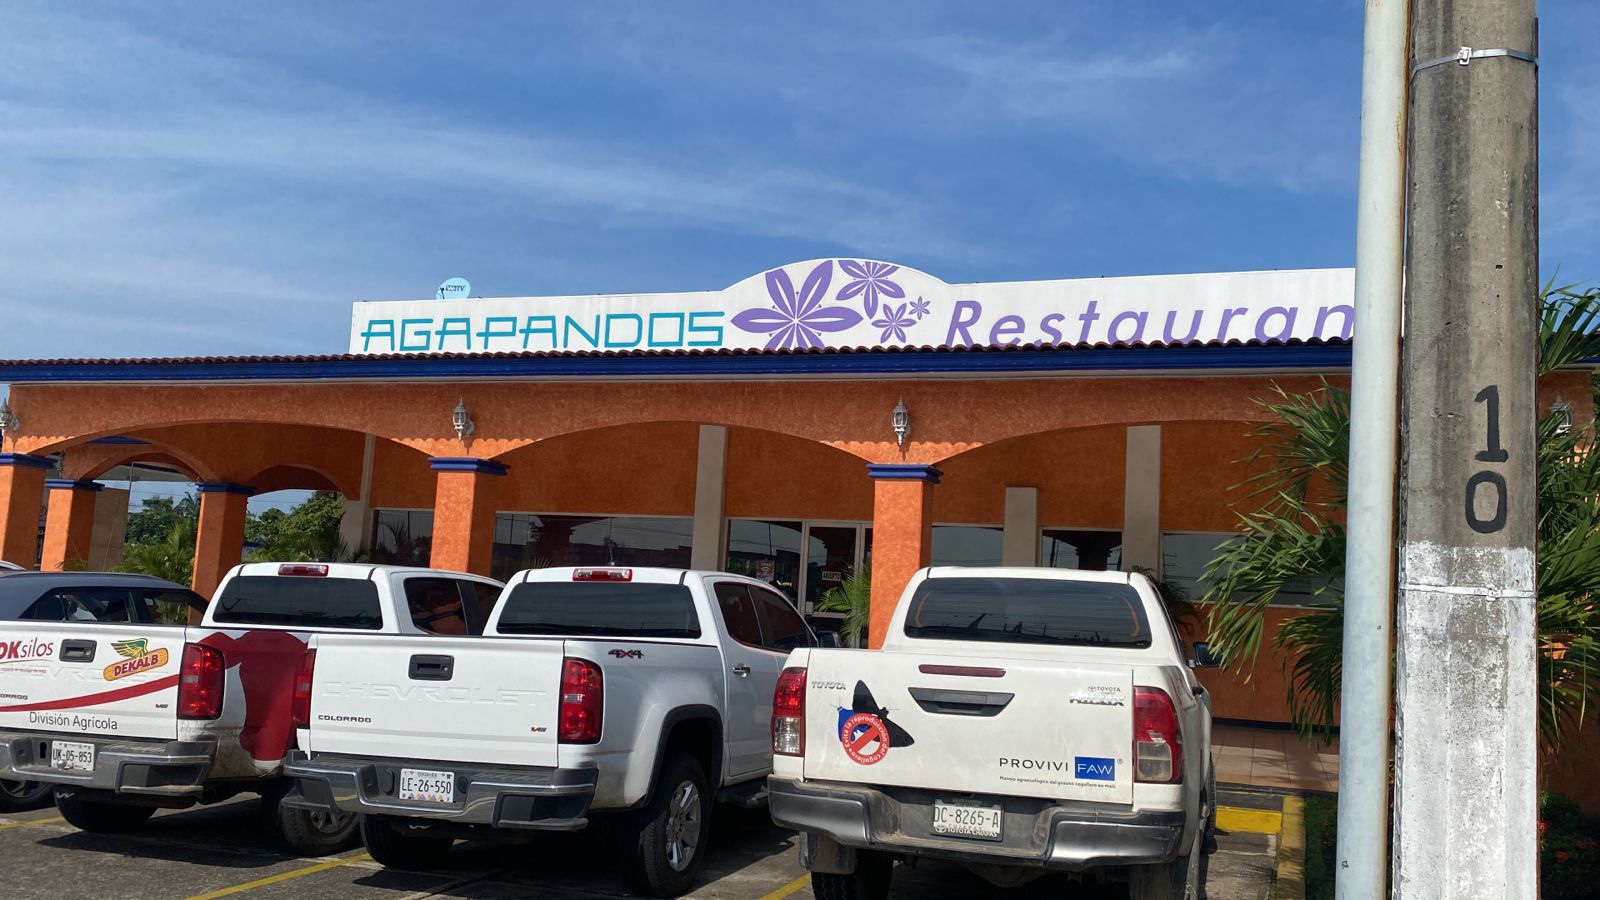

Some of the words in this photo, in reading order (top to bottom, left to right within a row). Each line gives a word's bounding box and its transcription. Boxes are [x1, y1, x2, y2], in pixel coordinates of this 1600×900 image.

[360, 311, 725, 352] AGAPANDOS
[114, 654, 158, 676] DEKALB
[322, 681, 547, 706] CHEVROLET
[811, 681, 846, 690] TOYOTA
[29, 711, 70, 726] División
[72, 715, 118, 731] Agrícola
[318, 714, 372, 723] COLORADO
[851, 716, 888, 742] reproducción
[53, 748, 92, 763] UK-05-853
[851, 752, 881, 763] cogollero
[880, 743, 889, 755] del
[999, 758, 1068, 772] PROVIVI
[1077, 763, 1113, 775] FAW
[402, 777, 451, 794] LE-26-550
[934, 806, 999, 828] DC-8265-A
